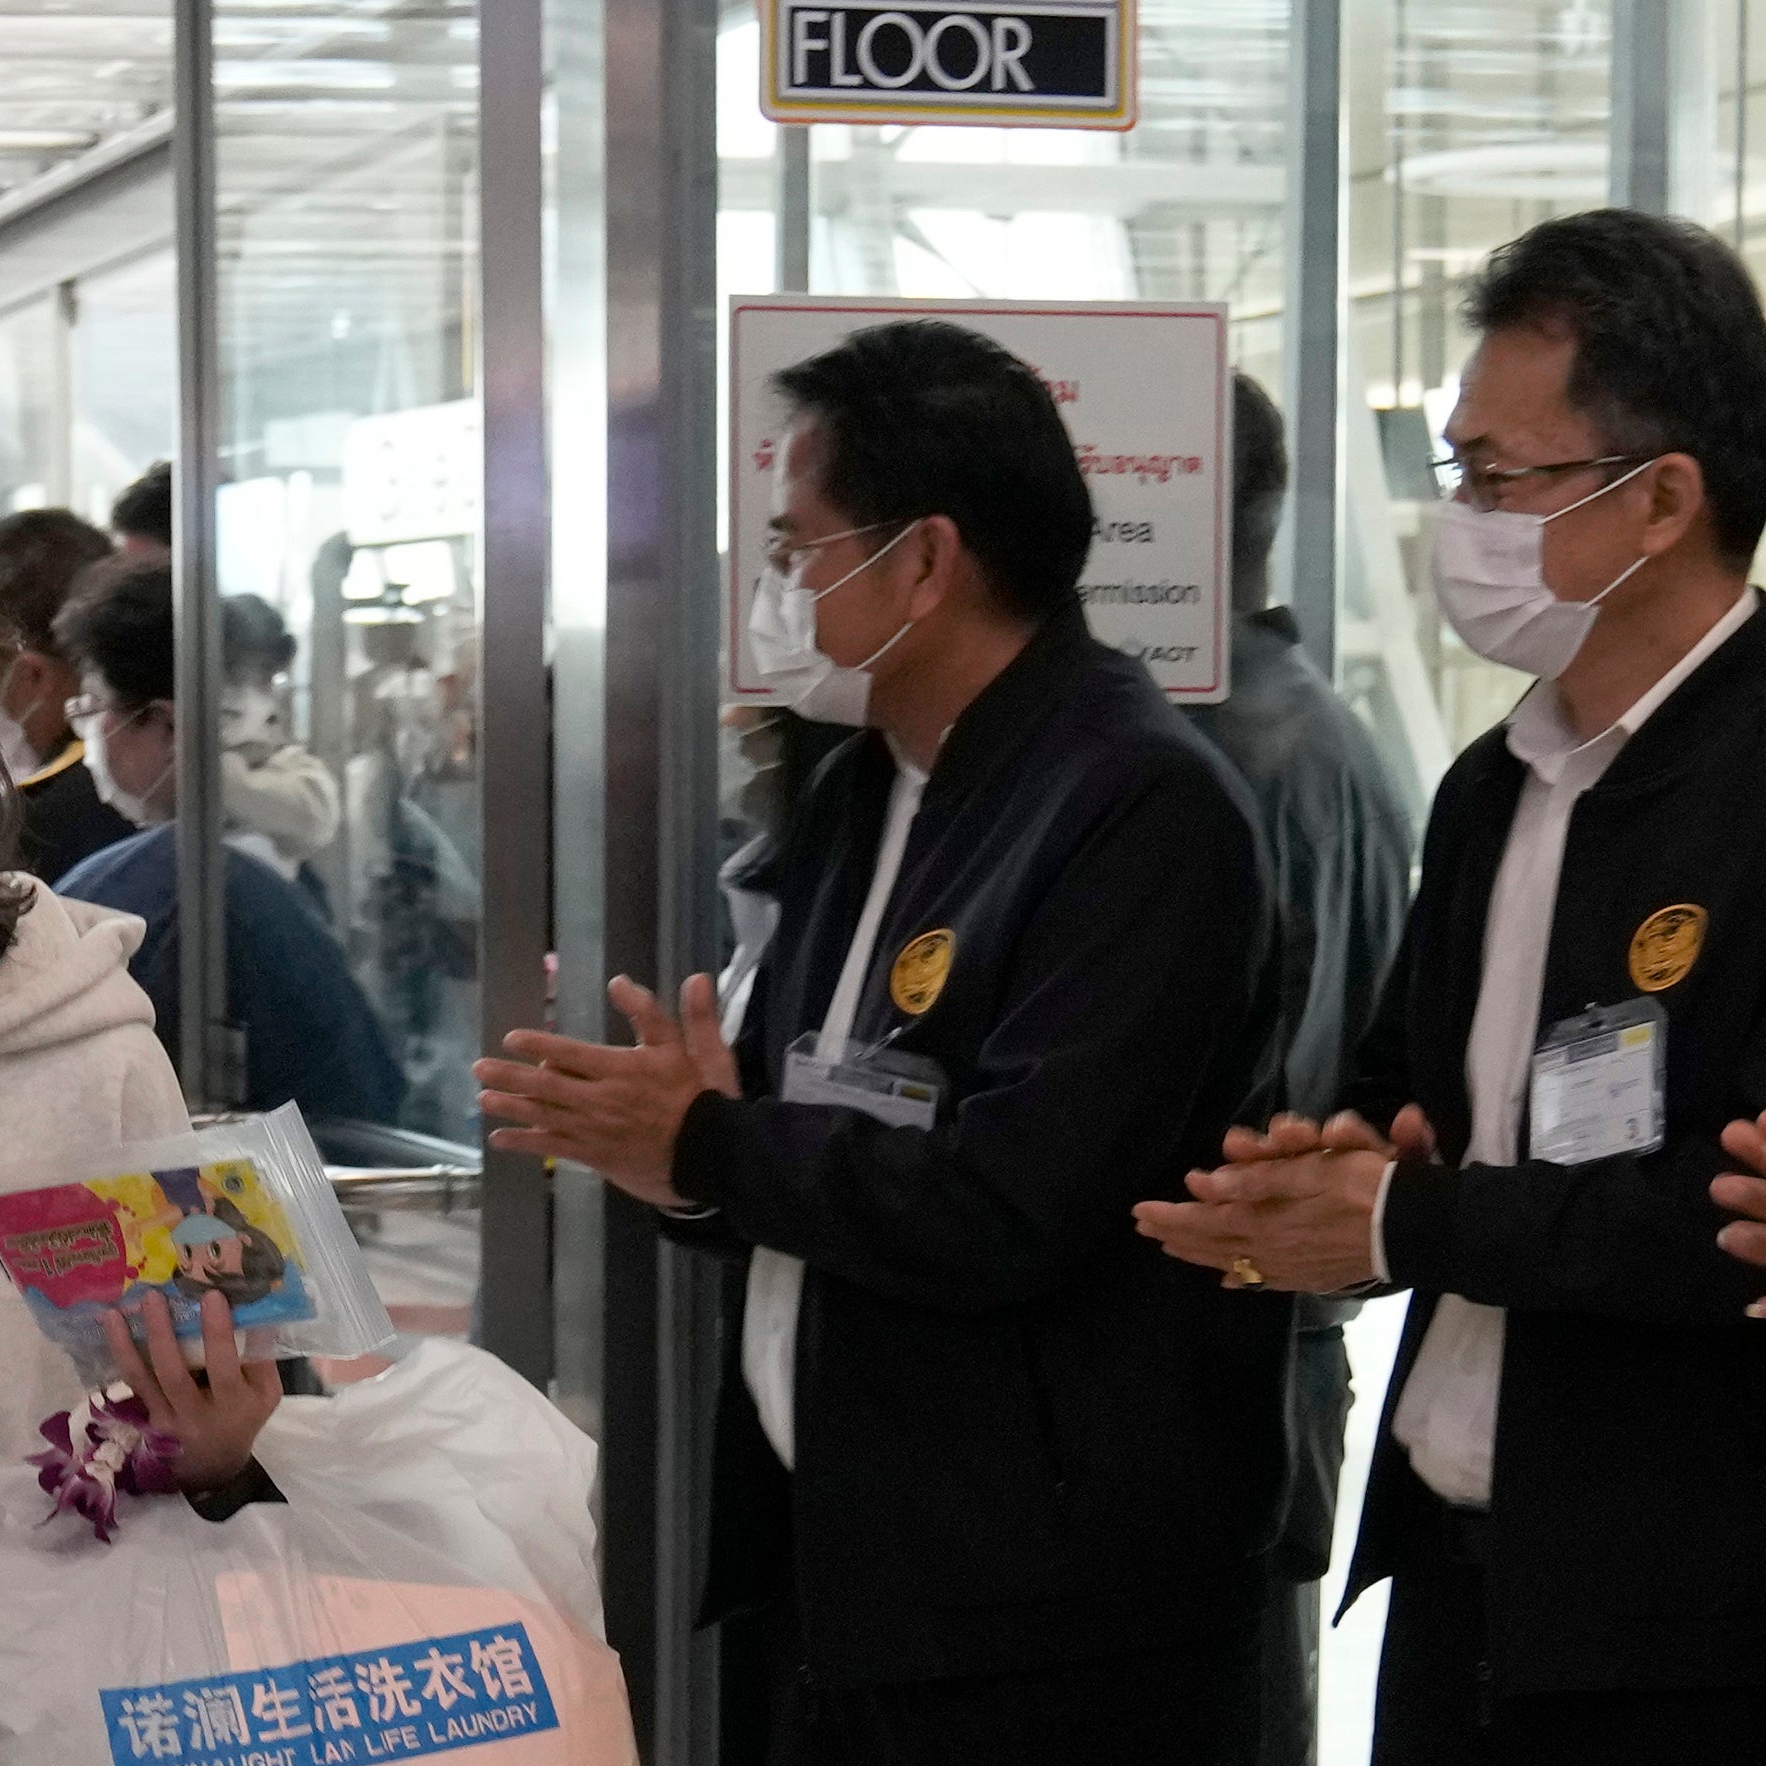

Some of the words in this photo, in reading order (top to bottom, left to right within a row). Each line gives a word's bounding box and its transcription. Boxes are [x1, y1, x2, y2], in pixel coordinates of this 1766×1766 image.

[792, 11, 1034, 91] FLOOR
[1076, 579, 1201, 605] ermission
[118, 1634, 534, 1760] 诺澜生活洗衣馆
[311, 1738, 356, 1766] LAN
[366, 1724, 420, 1758] LIFE
[428, 1702, 538, 1743] LAUNDRY
